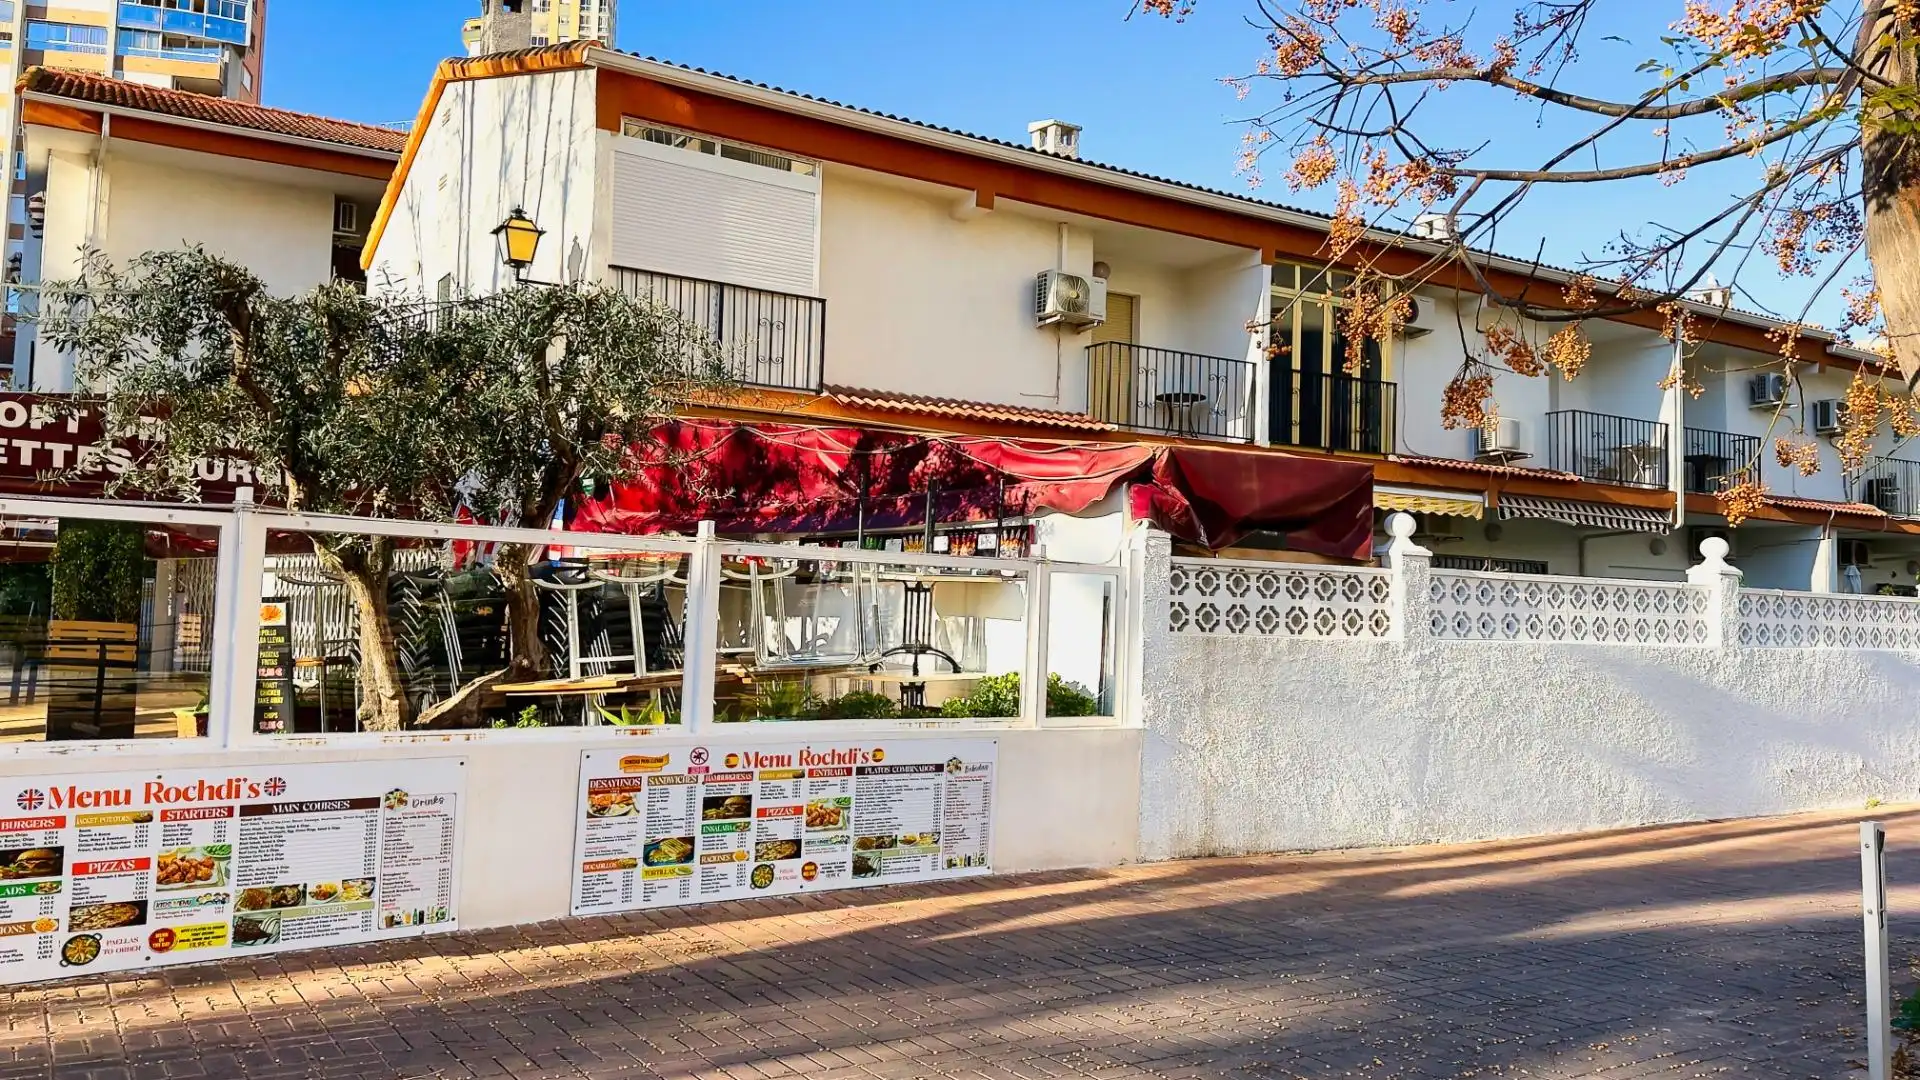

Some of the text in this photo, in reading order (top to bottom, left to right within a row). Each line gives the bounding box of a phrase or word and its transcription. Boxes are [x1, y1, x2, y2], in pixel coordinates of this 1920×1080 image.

[742, 748, 870, 769] Menu Rochdi's
[813, 768, 847, 776] ENTRADA
[865, 764, 936, 774] PLATOS COMBINADOS
[590, 777, 640, 788] DESAYUNOS
[648, 775, 697, 785] SANDWICHES
[48, 777, 261, 810] Menu Rochdi's
[272, 800, 351, 814] MAIN COURSES
[412, 796, 445, 808] Drinks
[167, 807, 228, 820] STARTERS
[766, 807, 794, 816] PIZZAS
[1, 819, 56, 830] BURGERS
[701, 855, 731, 863] RACIONES
[88, 860, 135, 873] PIZZAS
[584, 862, 617, 870] BOCADILLOS
[644, 868, 675, 877] TORTILLAS
[107, 937, 139, 946] PAELLAS
[115, 945, 141, 953] ORDER
